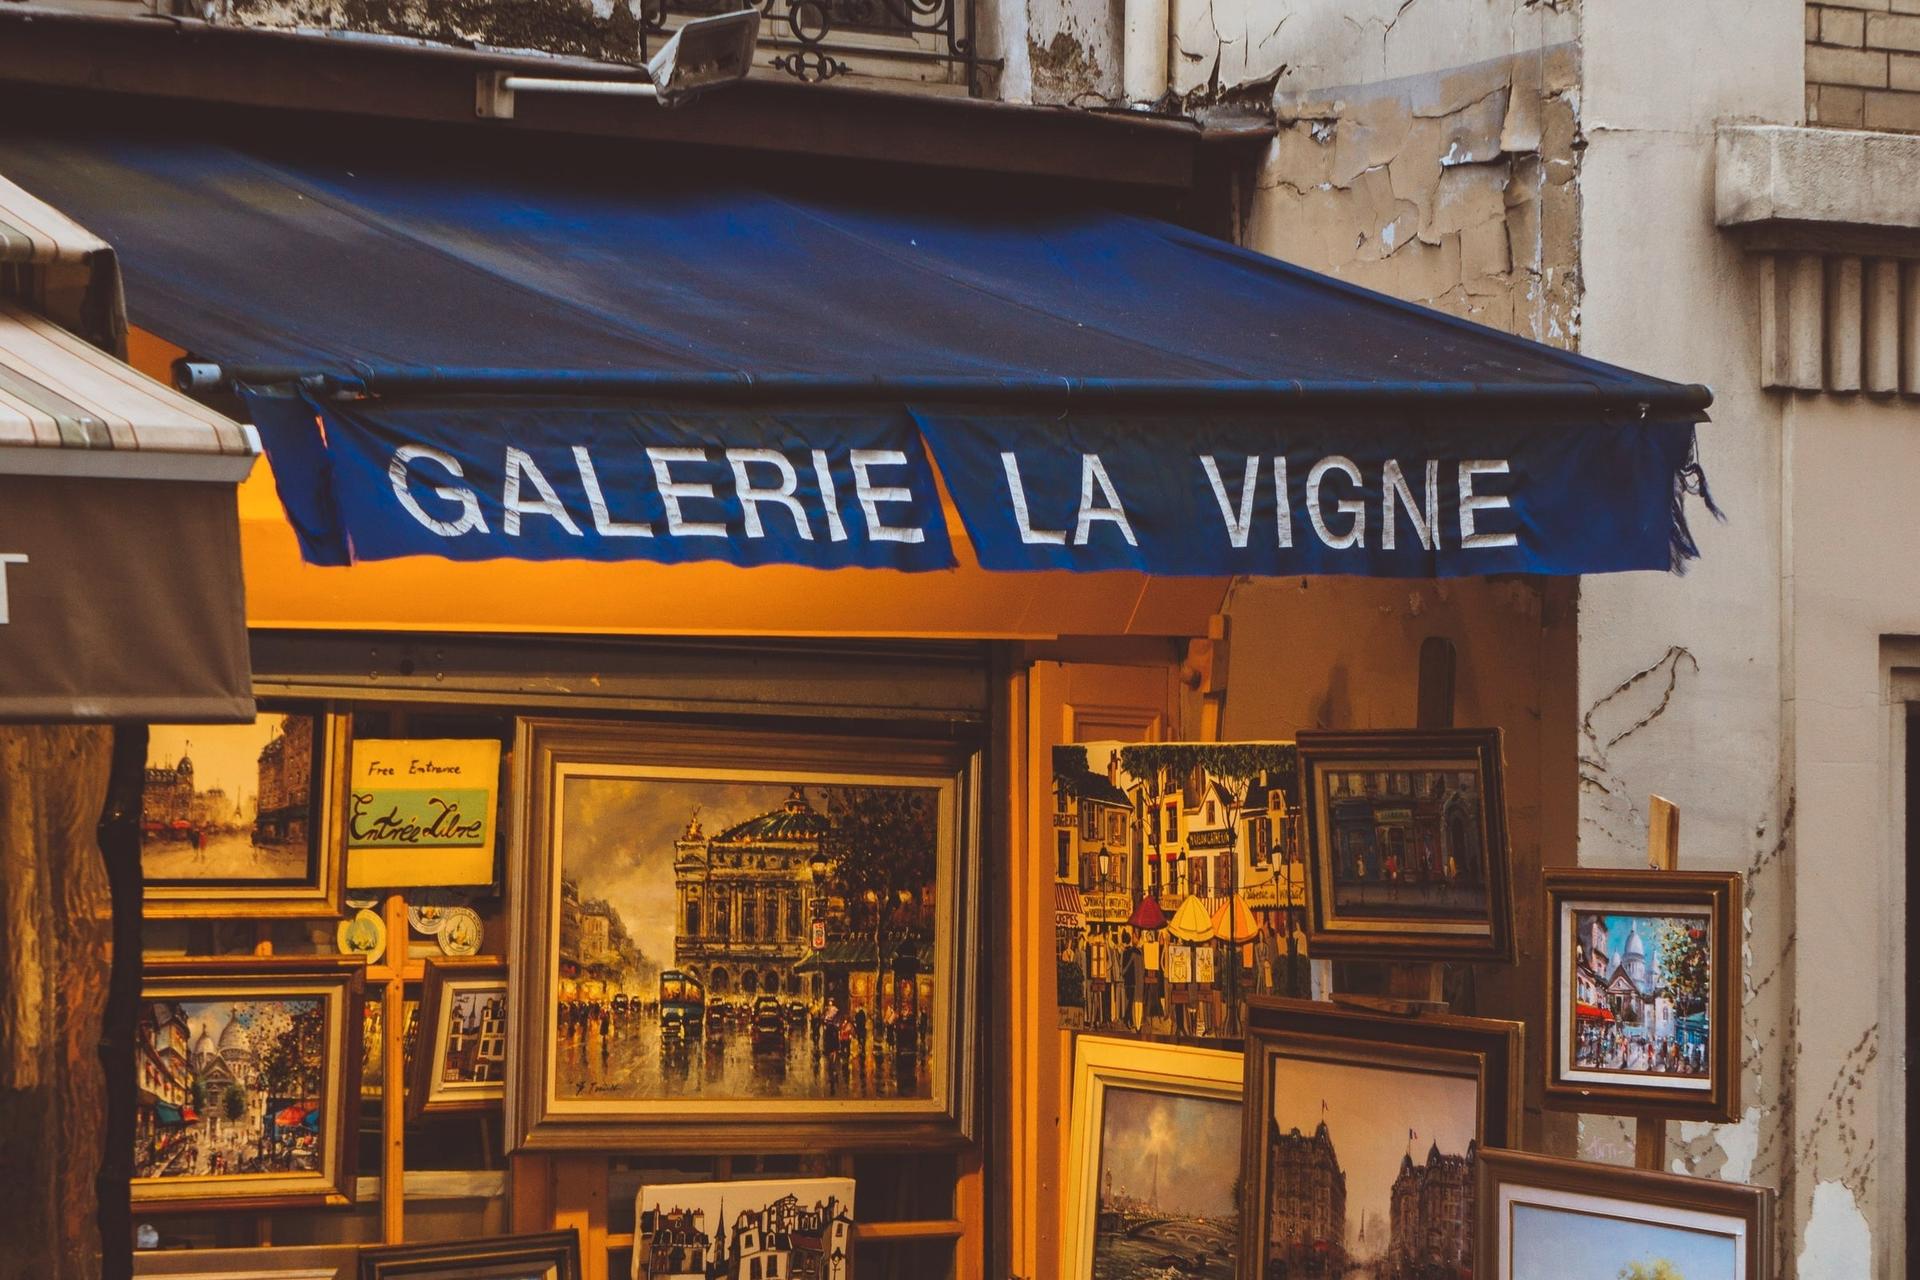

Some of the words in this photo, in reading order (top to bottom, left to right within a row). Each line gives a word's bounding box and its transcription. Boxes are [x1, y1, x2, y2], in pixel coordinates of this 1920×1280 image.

[388, 443, 925, 543] GALERIE
[1000, 452, 1138, 547] LA
[1200, 455, 1518, 550] VIGNE
[368, 761, 395, 776] Free
[408, 760, 462, 775] Entrance
[422, 797, 482, 839] Libre
